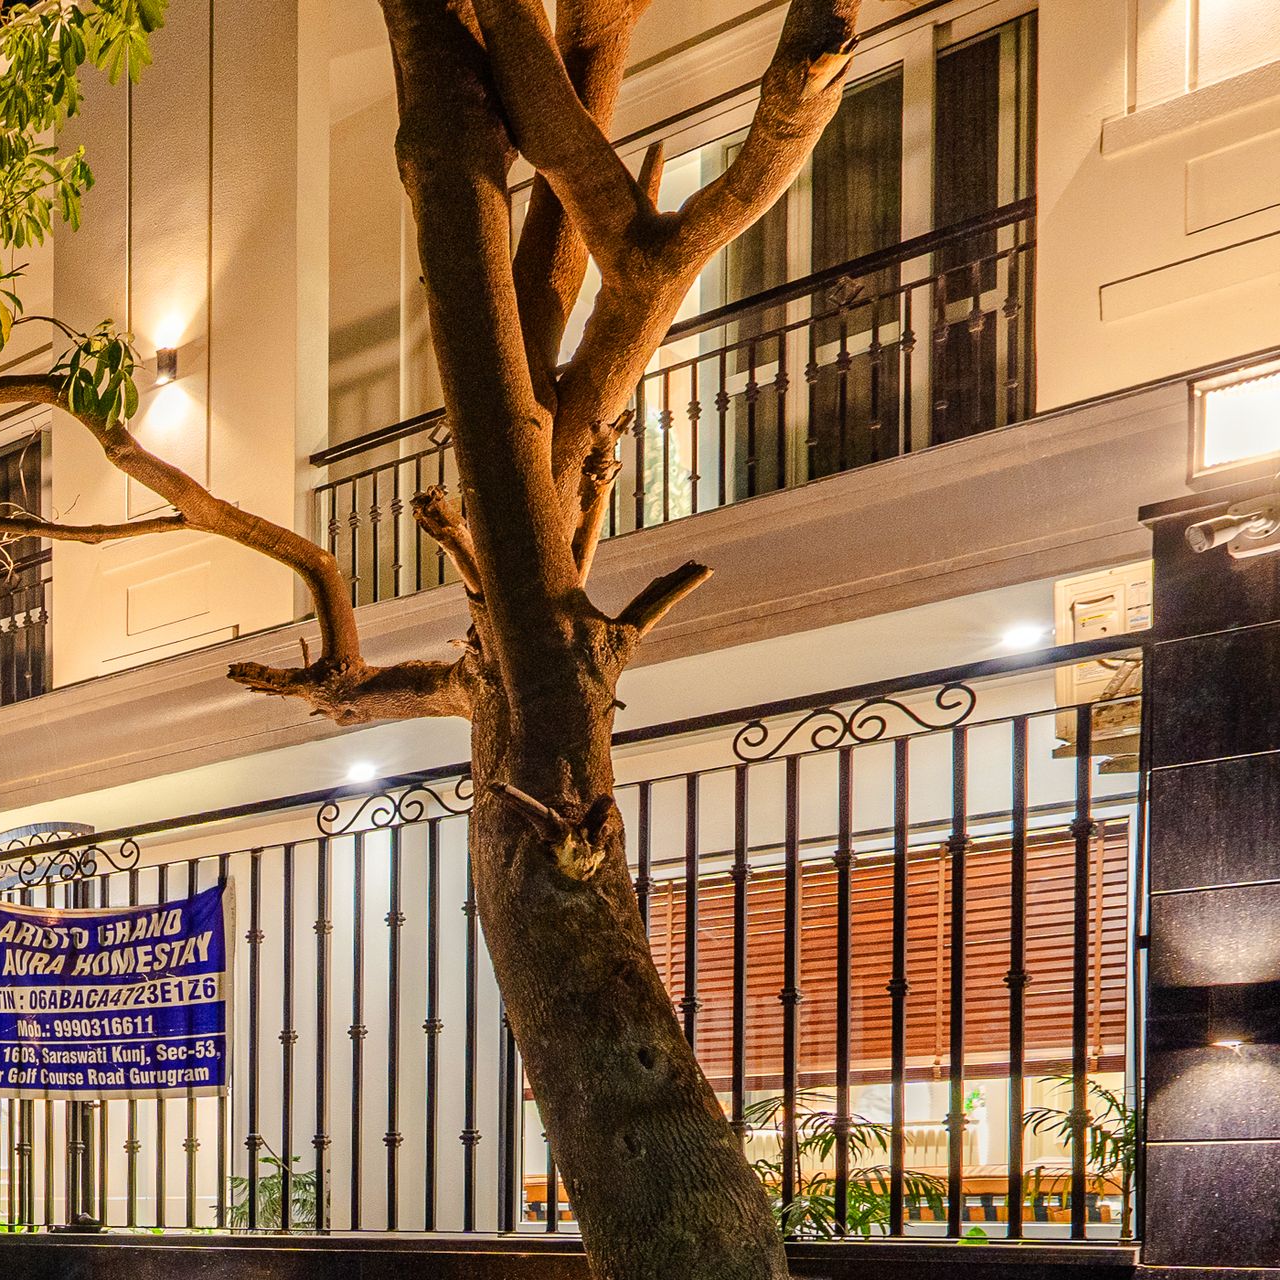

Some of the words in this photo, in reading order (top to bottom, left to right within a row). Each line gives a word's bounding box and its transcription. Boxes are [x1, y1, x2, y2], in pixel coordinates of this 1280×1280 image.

[97, 908, 183, 946] GRAND
[2, 948, 66, 976] AURA
[71, 930, 213, 976] HOMESTAY
[29, 977, 216, 1010] 06ABACA4723E1Z6
[17, 1019, 51, 1038] Mob.:
[53, 1014, 153, 1038] 9990316611
[3, 1046, 40, 1066] 1603,
[41, 1046, 107, 1064] Saraswati
[111, 1044, 151, 1066] Kunj,
[156, 1039, 221, 1061] Sec-53,
[7, 1067, 38, 1084] Golf
[40, 1068, 84, 1086] Course
[87, 1067, 125, 1085] Road
[129, 1066, 210, 1087] Gurugram
